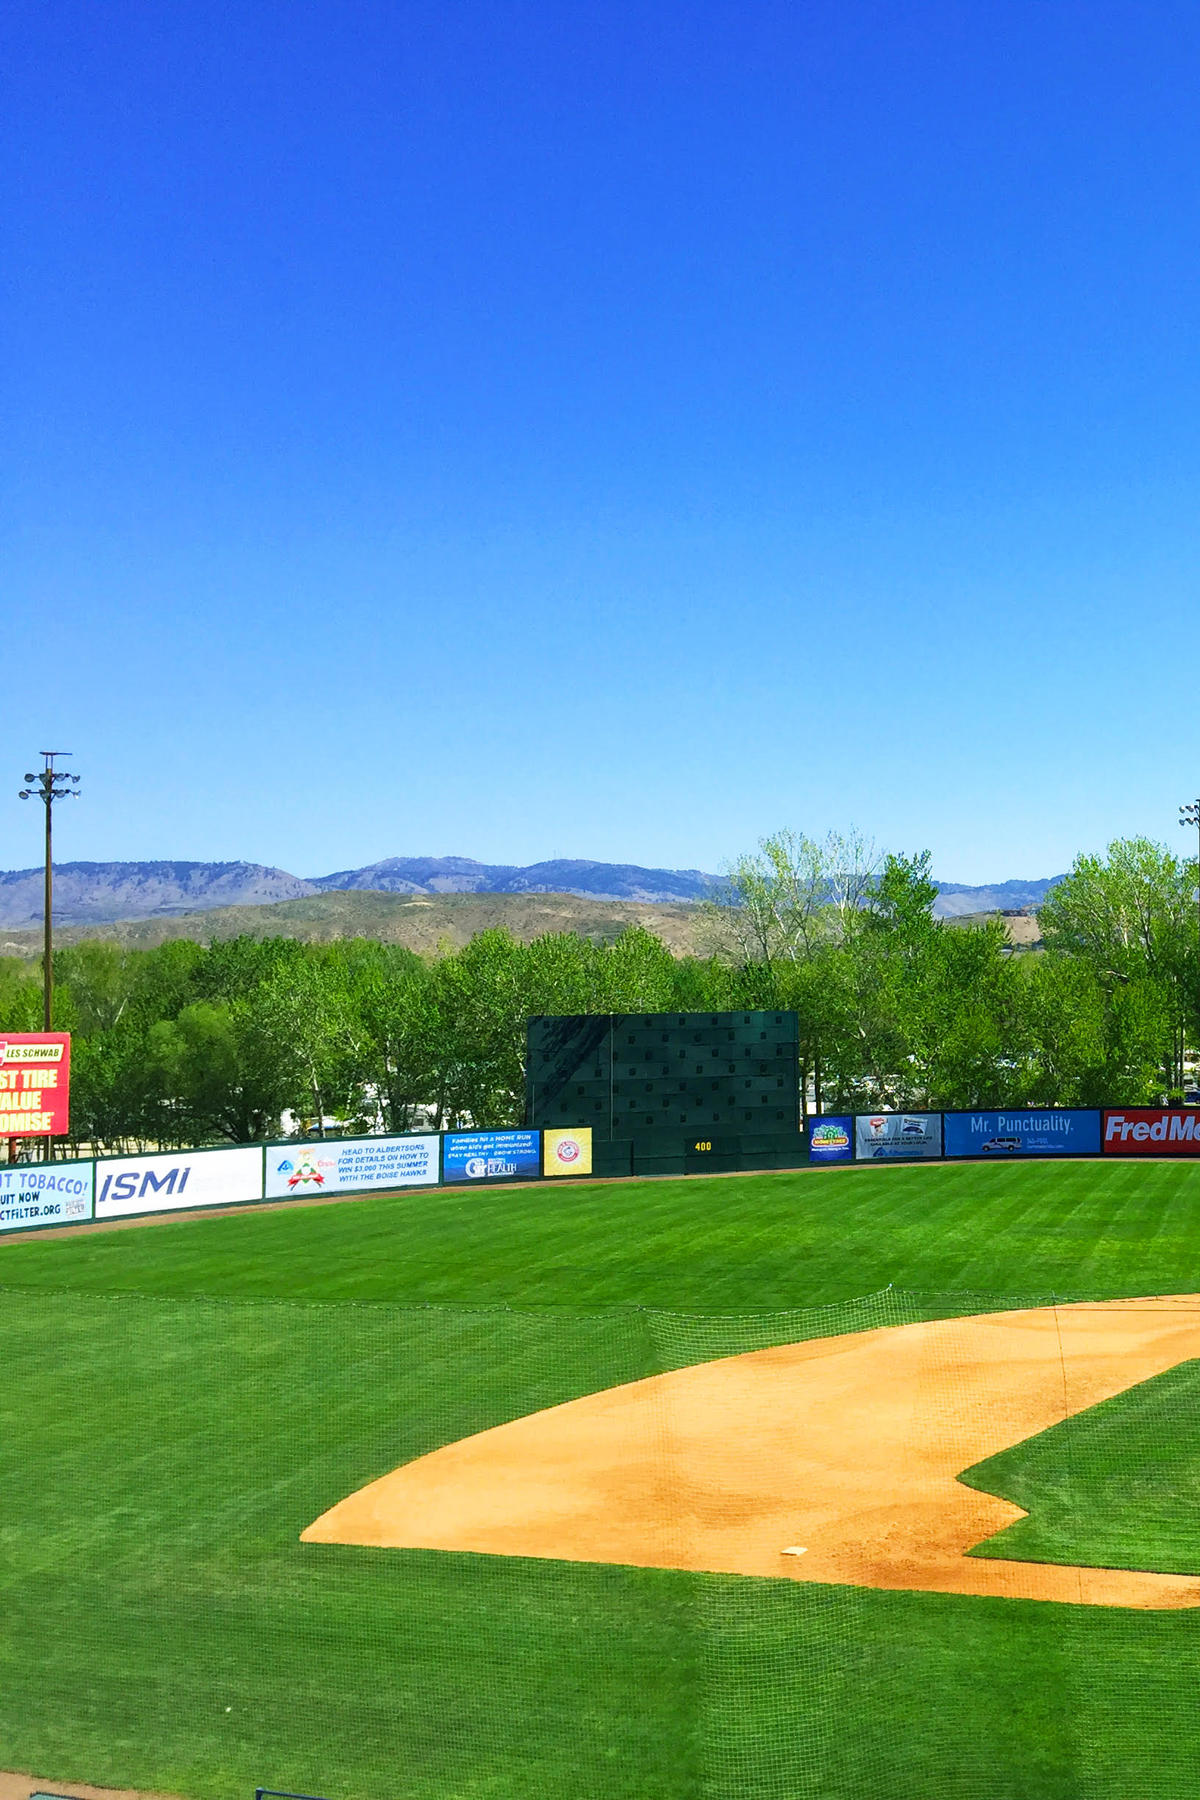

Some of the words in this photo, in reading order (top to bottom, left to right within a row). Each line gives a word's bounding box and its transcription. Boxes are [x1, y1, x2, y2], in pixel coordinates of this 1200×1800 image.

[7, 1049, 20, 1058] LES
[22, 1048, 59, 1057] SCHWAB
[21, 1069, 58, 1088] TIRE
[0, 1091, 42, 1110] ALUE
[971, 1117, 992, 1133] Mr.
[998, 1116, 1074, 1135] Punctuality.
[342, 1148, 362, 1156] HEAD
[376, 1144, 424, 1153] ALBERTSONS
[695, 1142, 712, 1151] 400
[356, 1156, 386, 1164] DETAILS
[396, 1160, 428, 1168] SUMMER
[376, 1172, 398, 1180] BOISE
[400, 1169, 427, 1177] HAWKS
[19, 1172, 89, 1196] TOBACCO!
[18, 1192, 40, 1204] NOW
